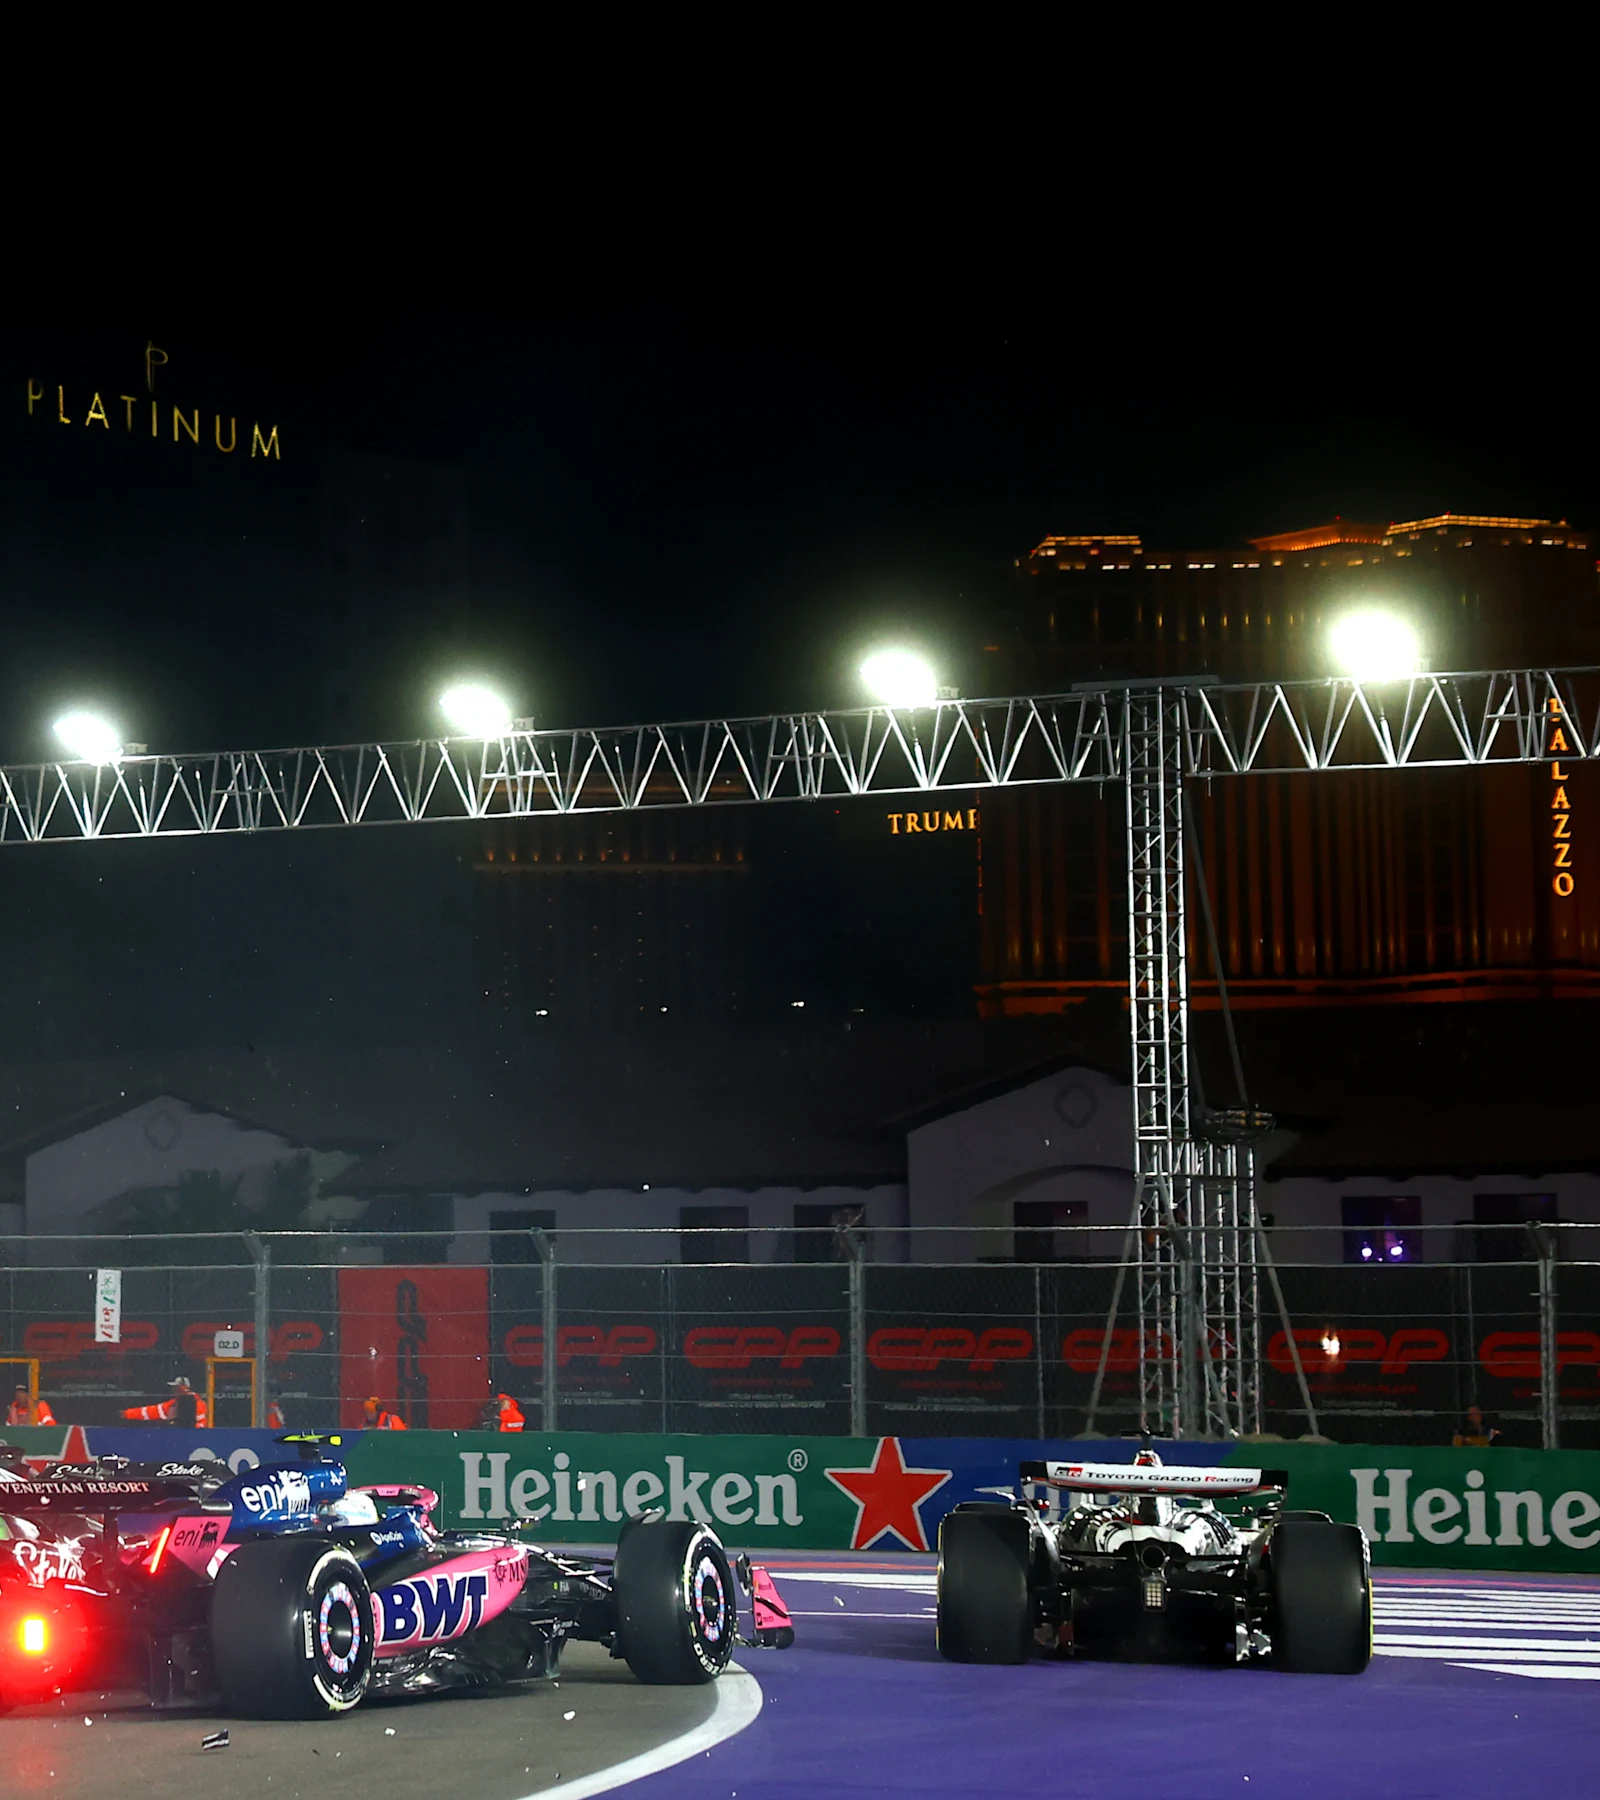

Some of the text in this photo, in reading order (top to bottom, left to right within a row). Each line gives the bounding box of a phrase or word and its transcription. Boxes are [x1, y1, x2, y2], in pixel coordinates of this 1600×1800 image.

[27, 378, 281, 460] PLATINUM
[156, 1463, 203, 1477] Stake
[1086, 1471, 1143, 1481] TOYOTA
[1148, 1474, 1201, 1482] GAZOO
[1205, 1476, 1253, 1484] Racing
[1, 1482, 83, 1494] VENETIAN
[89, 1482, 150, 1493] RESORT
[241, 1475, 285, 1512] eni
[459, 1452, 803, 1527] Heineken
[174, 1525, 202, 1547] eni
[379, 1575, 489, 1645] BWT
